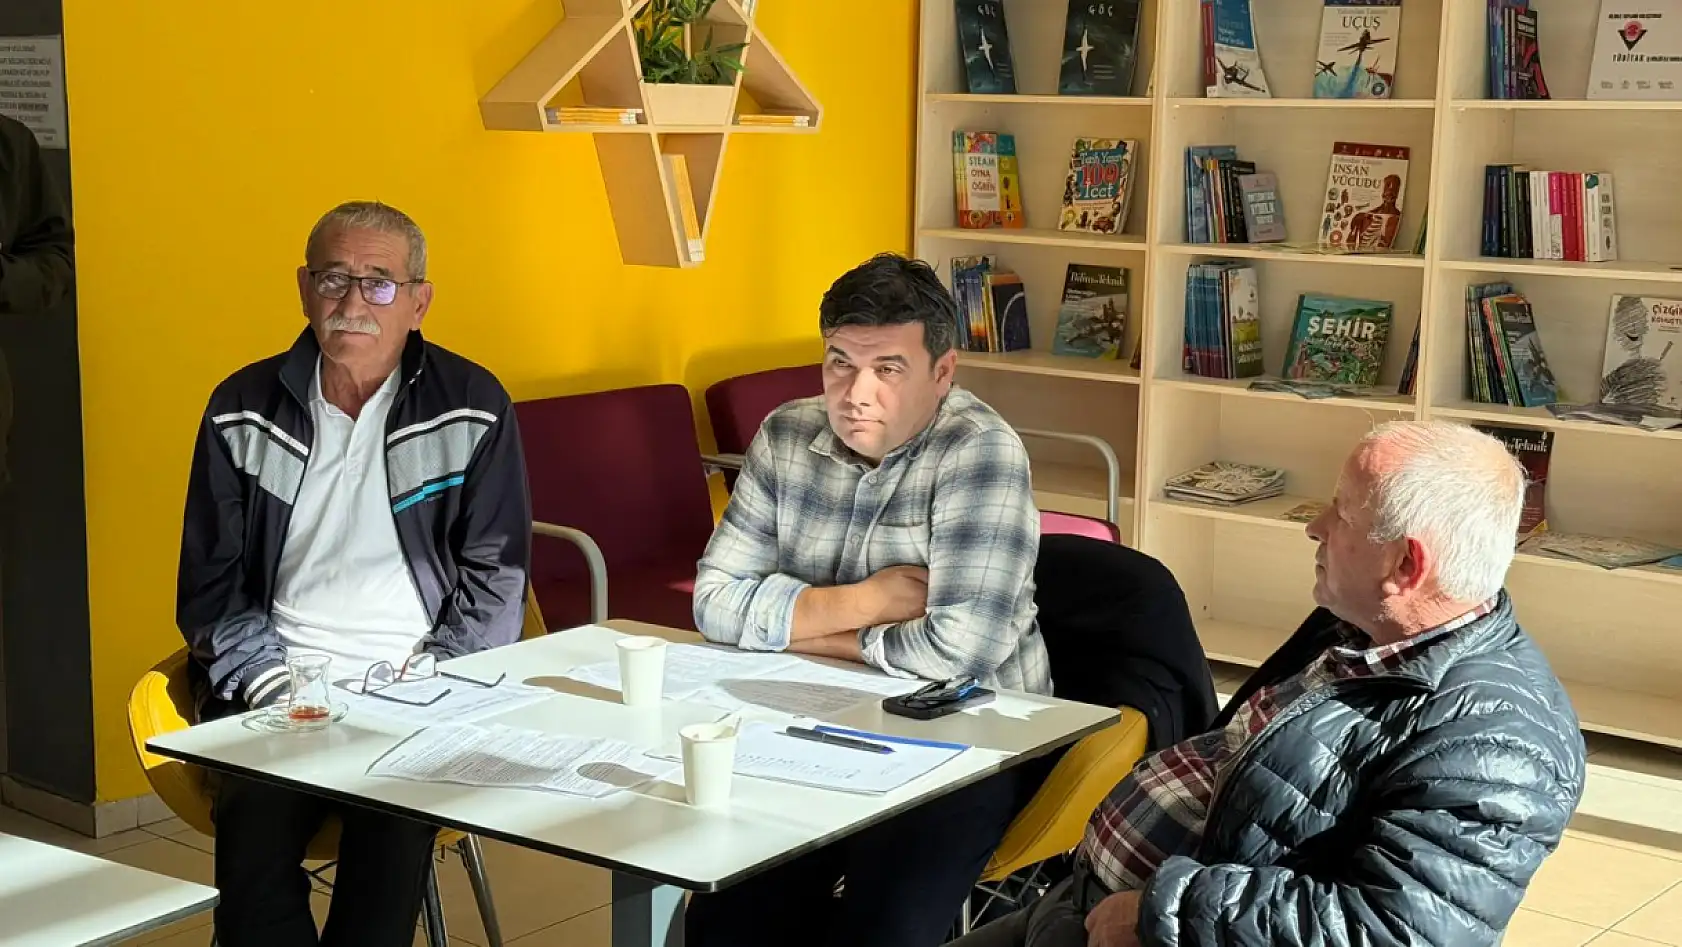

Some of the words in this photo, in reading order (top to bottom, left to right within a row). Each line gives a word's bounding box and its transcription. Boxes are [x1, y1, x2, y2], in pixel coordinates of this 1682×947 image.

[977, 3, 996, 18] GÖÇ
[1088, 3, 1113, 18] GÖÇ
[1342, 15, 1382, 31] UÇUŞ
[969, 156, 994, 167] STEAM
[1080, 161, 1119, 188] 100
[1307, 315, 1376, 340] ŞEHİR
